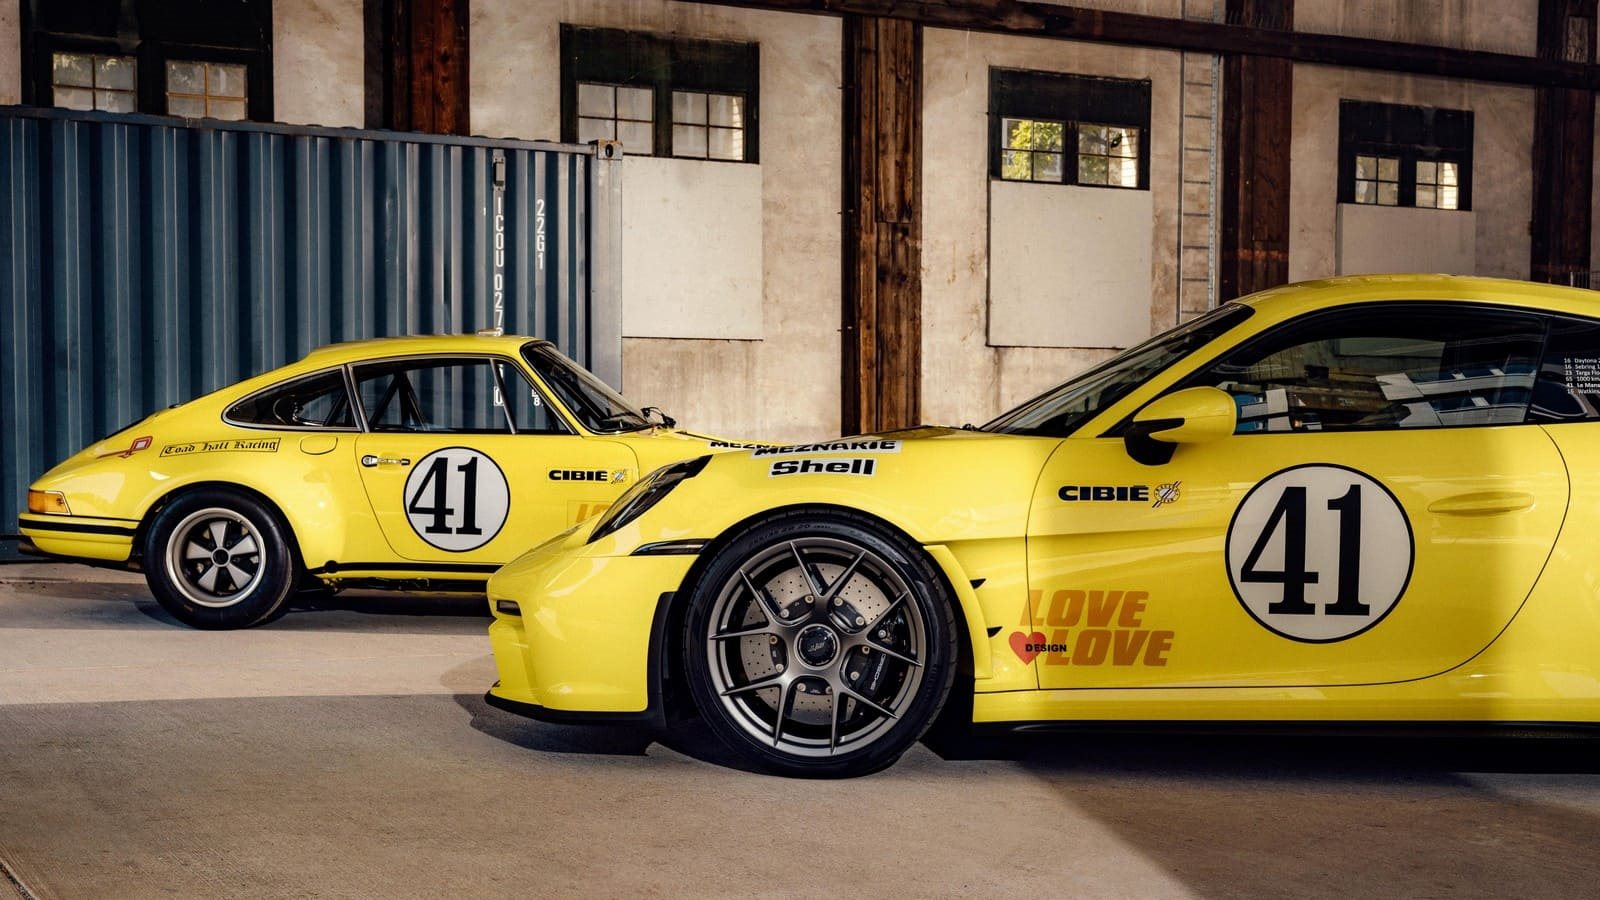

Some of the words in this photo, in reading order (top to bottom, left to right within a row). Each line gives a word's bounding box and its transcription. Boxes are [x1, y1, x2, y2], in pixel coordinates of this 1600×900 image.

[536, 199, 545, 270] 22G1
[164, 444, 195, 454] Toad
[234, 440, 277, 450] Racing
[771, 459, 874, 476] Shell
[408, 456, 483, 535] 41
[1240, 484, 1370, 616] 41
[1019, 589, 1149, 628] LOVE
[1025, 644, 1067, 652] DESIGN
[1045, 629, 1175, 666] LOVE
